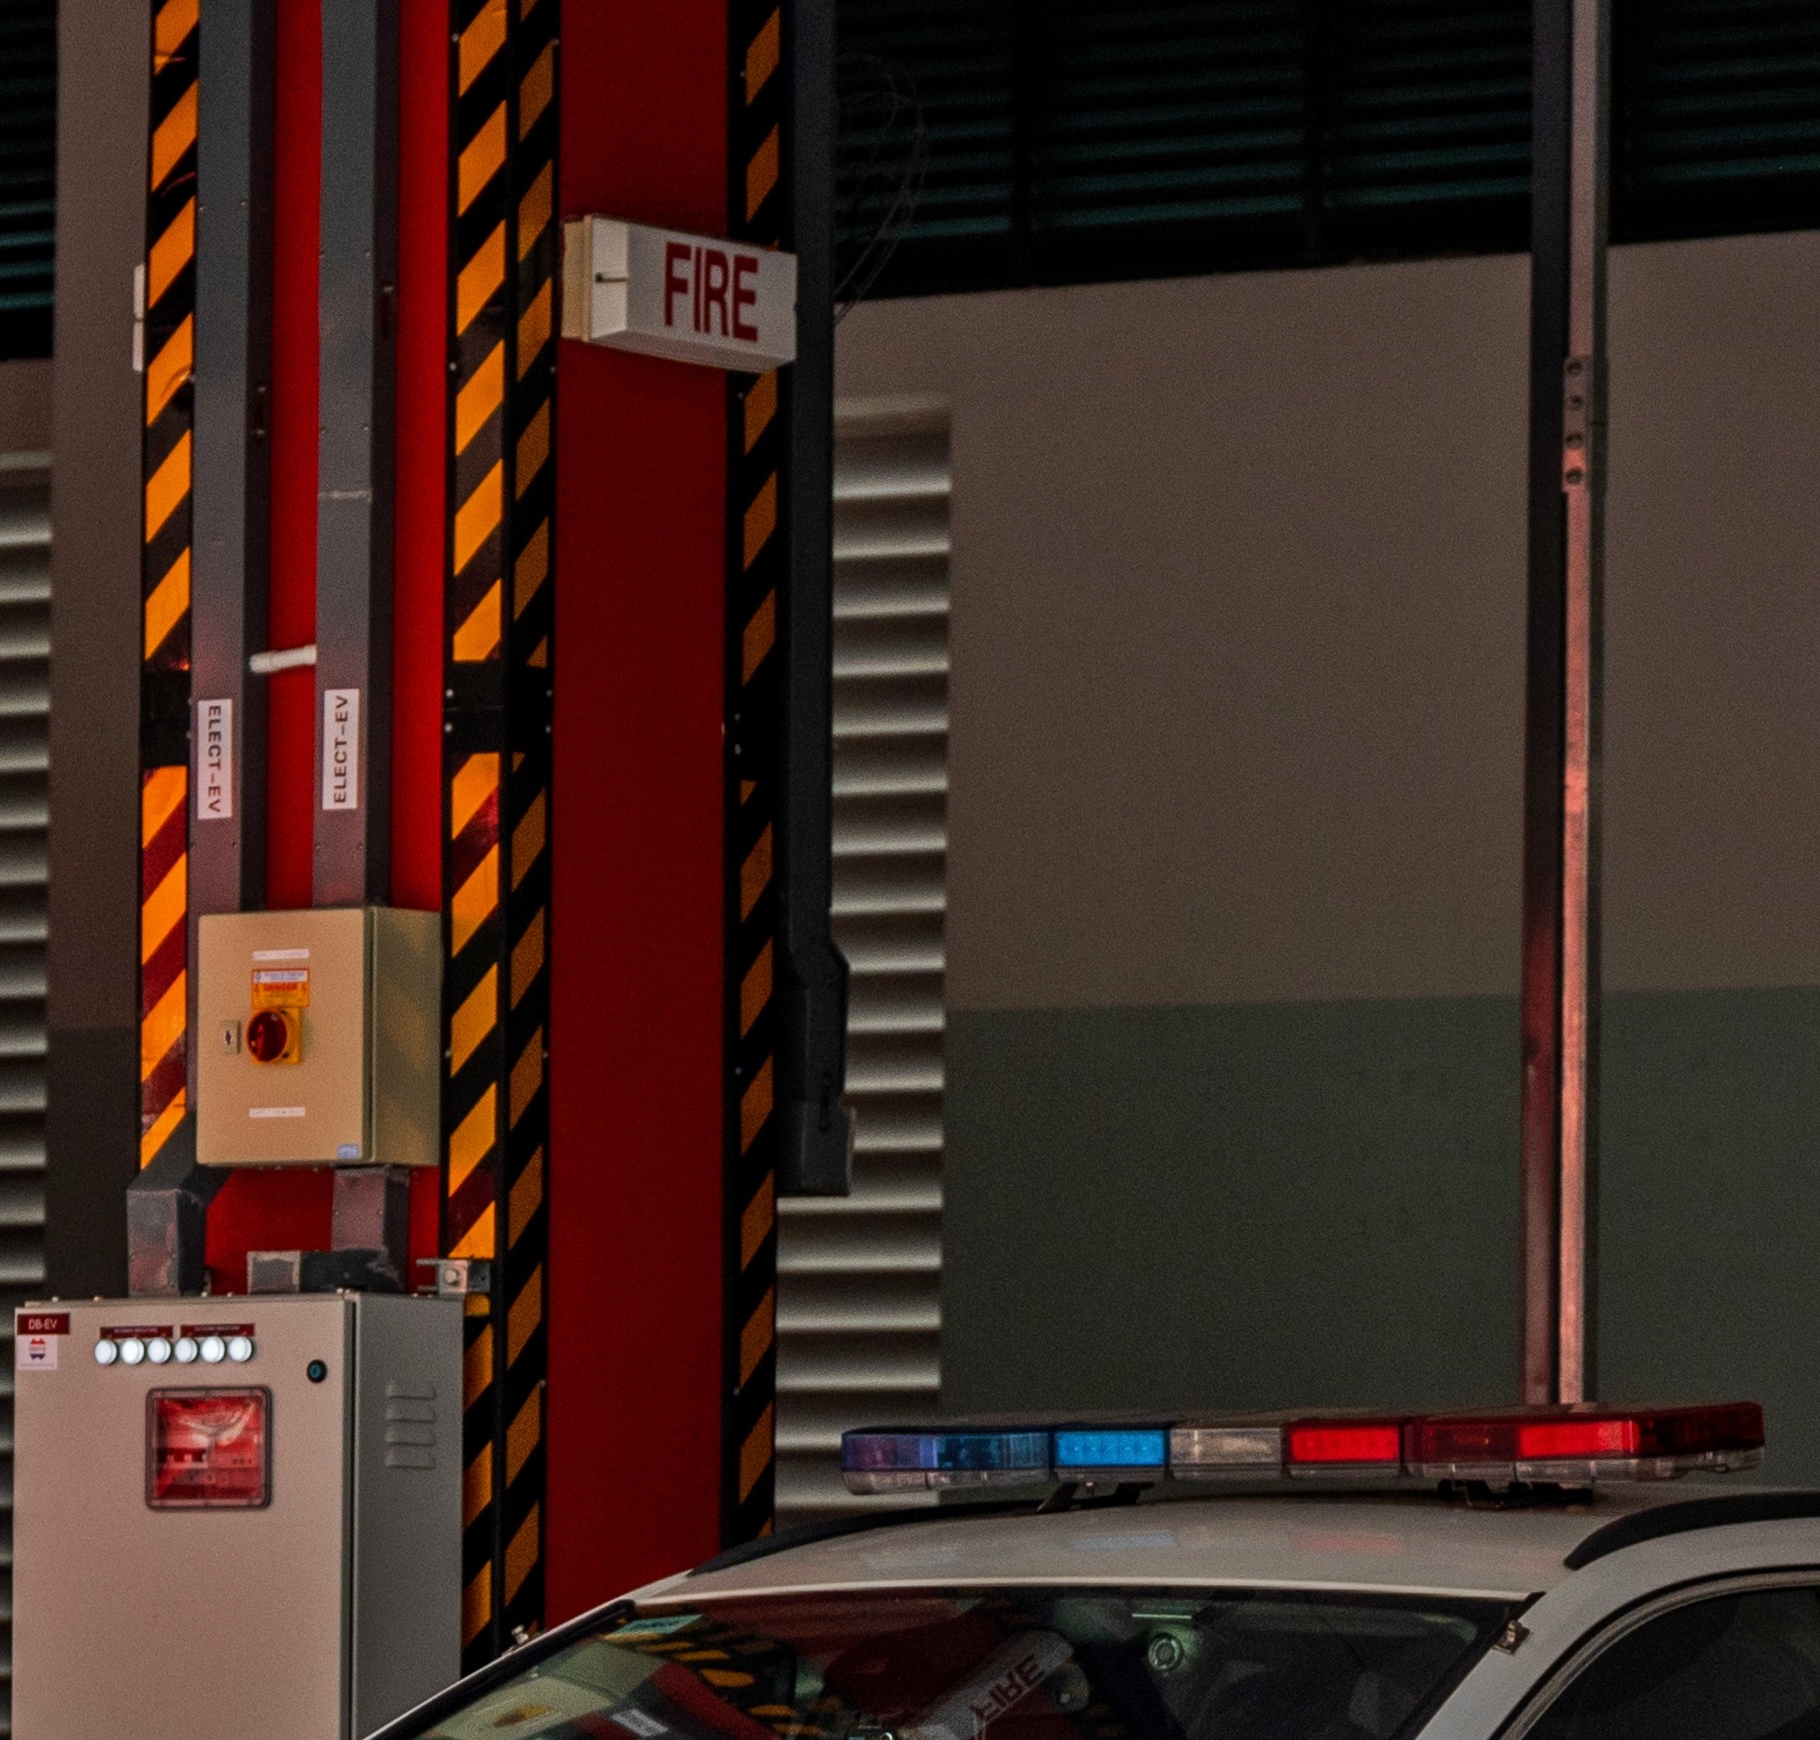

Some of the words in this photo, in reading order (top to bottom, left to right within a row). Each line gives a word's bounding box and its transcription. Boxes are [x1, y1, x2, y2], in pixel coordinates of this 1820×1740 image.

[664, 241, 758, 342] FIRE
[208, 705, 222, 812] ELECT-EV
[333, 695, 349, 803] ELECT-EV
